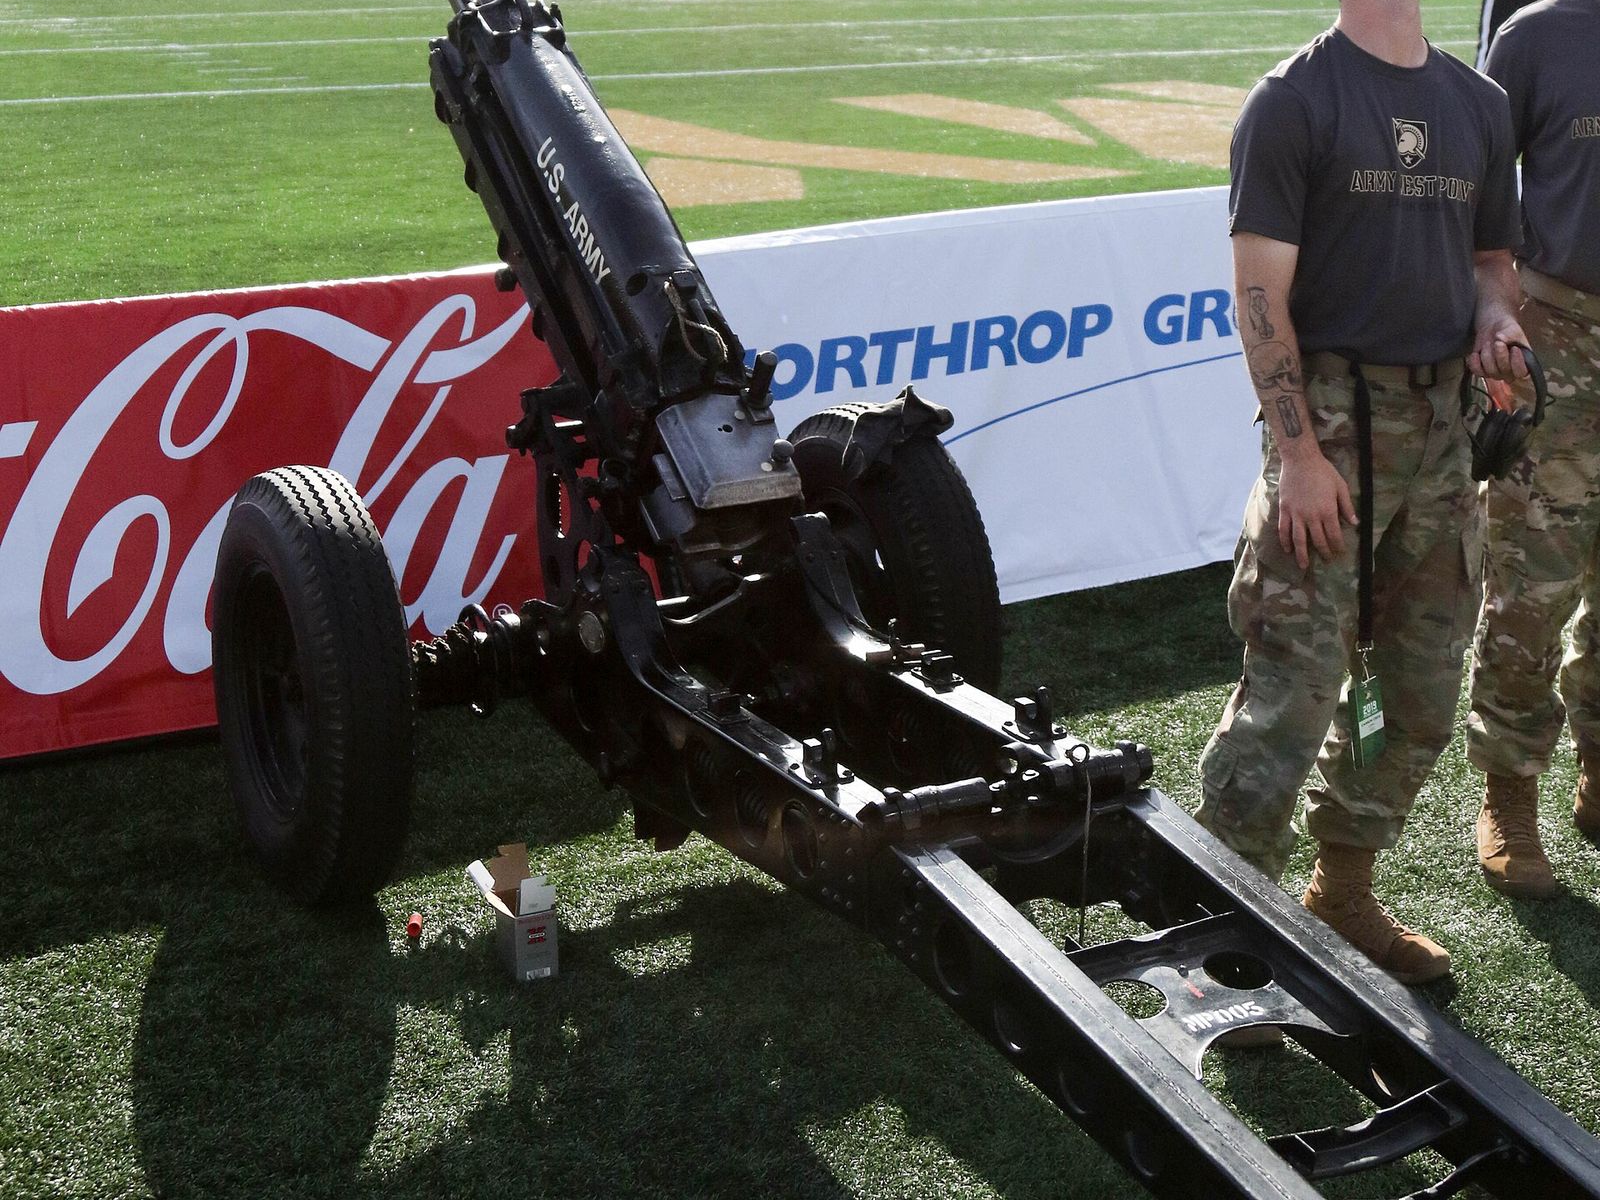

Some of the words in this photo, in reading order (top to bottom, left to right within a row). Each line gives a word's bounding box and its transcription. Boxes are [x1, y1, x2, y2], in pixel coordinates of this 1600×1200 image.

[536, 136, 565, 203] U.S.
[563, 201, 611, 285] ARMY
[1350, 169, 1397, 192] ARMY
[1400, 174, 1437, 197] EST
[743, 303, 1114, 401] ORTHROP
[1142, 288, 1238, 346] GR
[1362, 700, 1378, 715] 2019
